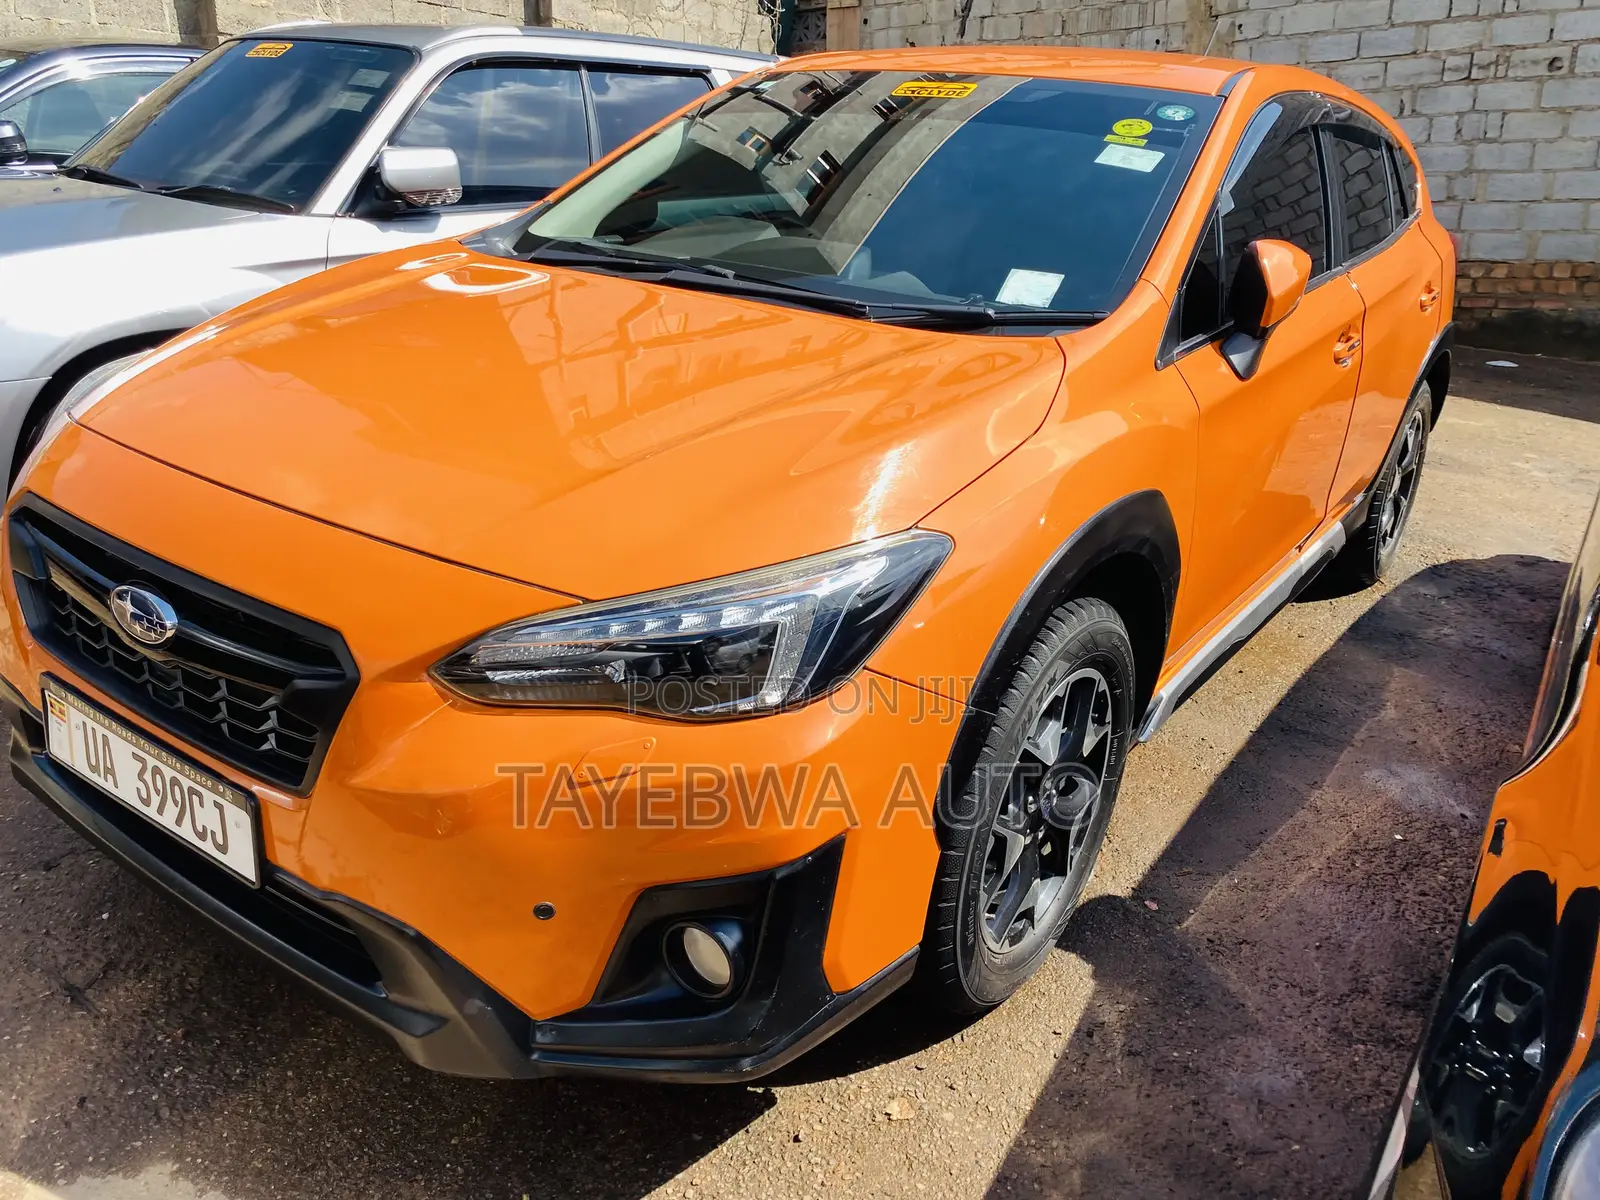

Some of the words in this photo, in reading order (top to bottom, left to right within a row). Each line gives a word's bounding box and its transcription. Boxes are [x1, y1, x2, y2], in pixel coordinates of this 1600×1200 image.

[82, 720, 119, 789] UA
[132, 751, 229, 855] 399CJ
[96, 712, 109, 727] the
[111, 721, 136, 744] Roads
[139, 738, 159, 756] Your
[161, 752, 181, 770] Safe
[184, 765, 212, 788] Space
